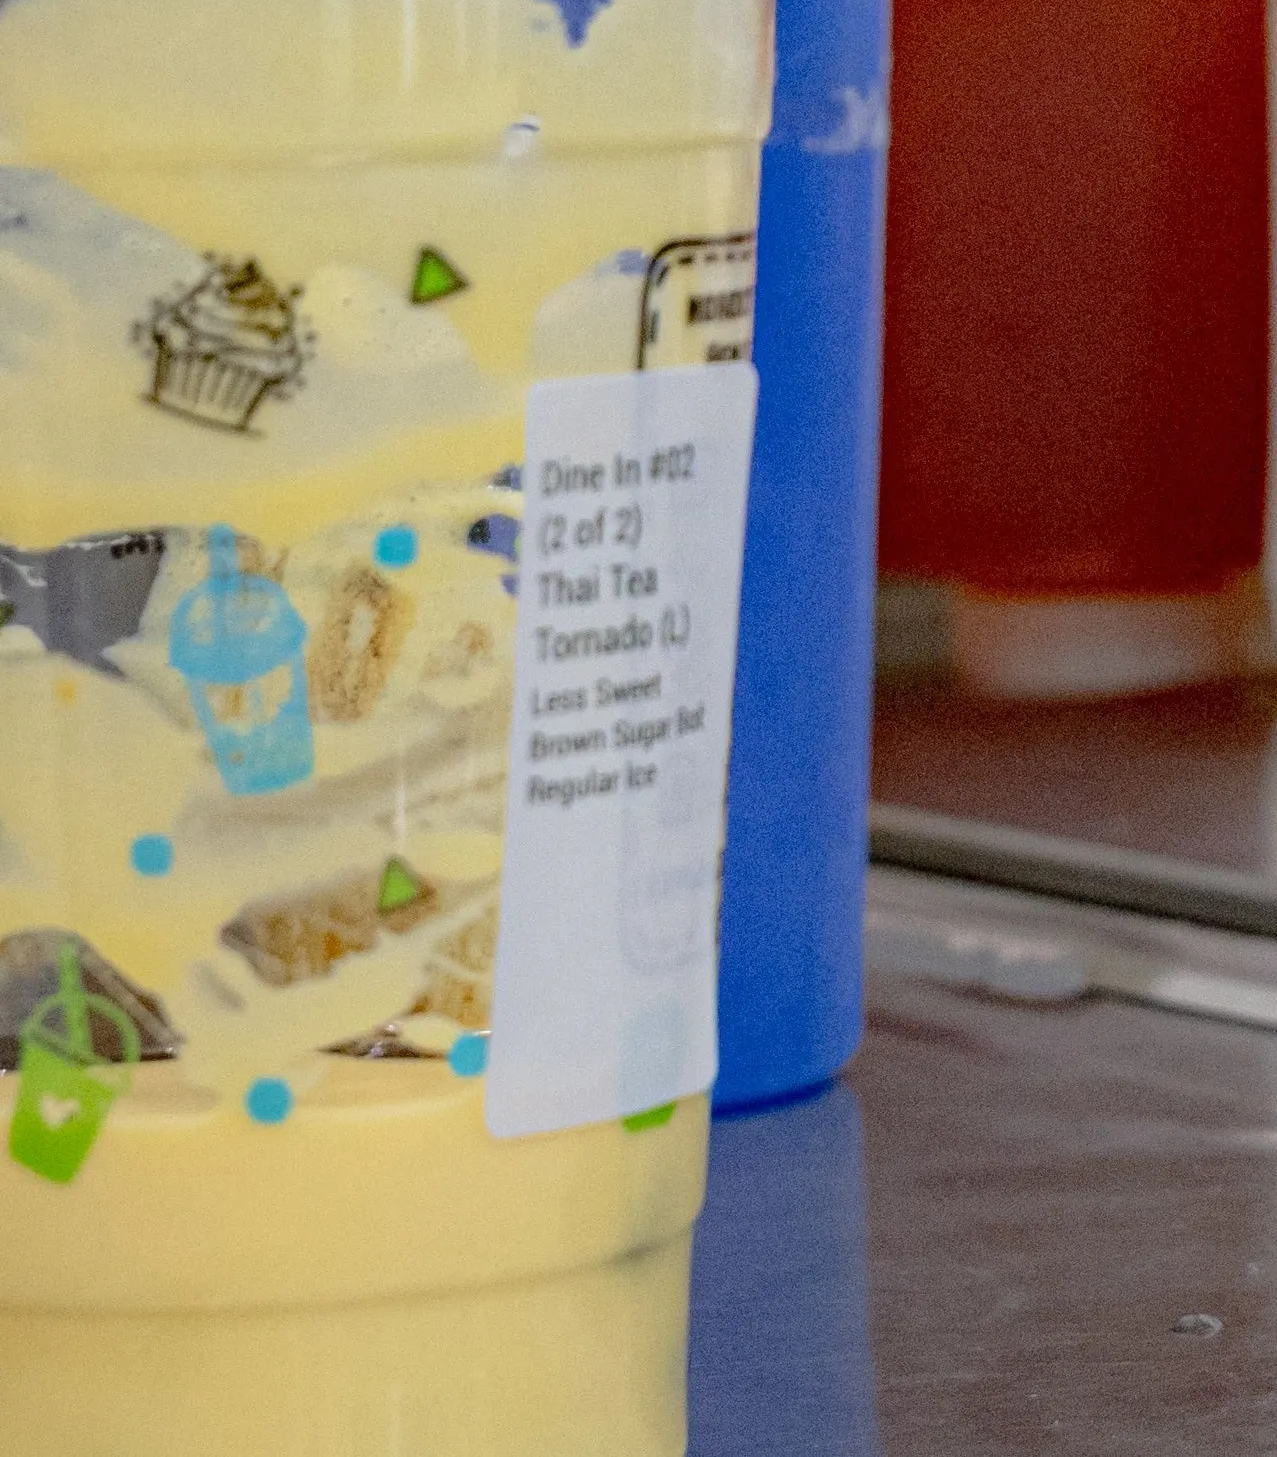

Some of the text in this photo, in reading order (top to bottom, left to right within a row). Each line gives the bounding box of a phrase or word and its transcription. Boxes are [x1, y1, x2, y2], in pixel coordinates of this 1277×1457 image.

[541, 442, 696, 495] Dine In #02
[537, 512, 567, 555] (2
[573, 506, 606, 550] of
[613, 501, 643, 551] 2)
[537, 562, 658, 607] Thai Tea
[535, 601, 691, 662] Tornado (L)
[530, 673, 662, 719] Less Sweet
[529, 729, 607, 763] Brown
[613, 717, 671, 750] Sugar
[526, 759, 657, 809] Regular Ice
